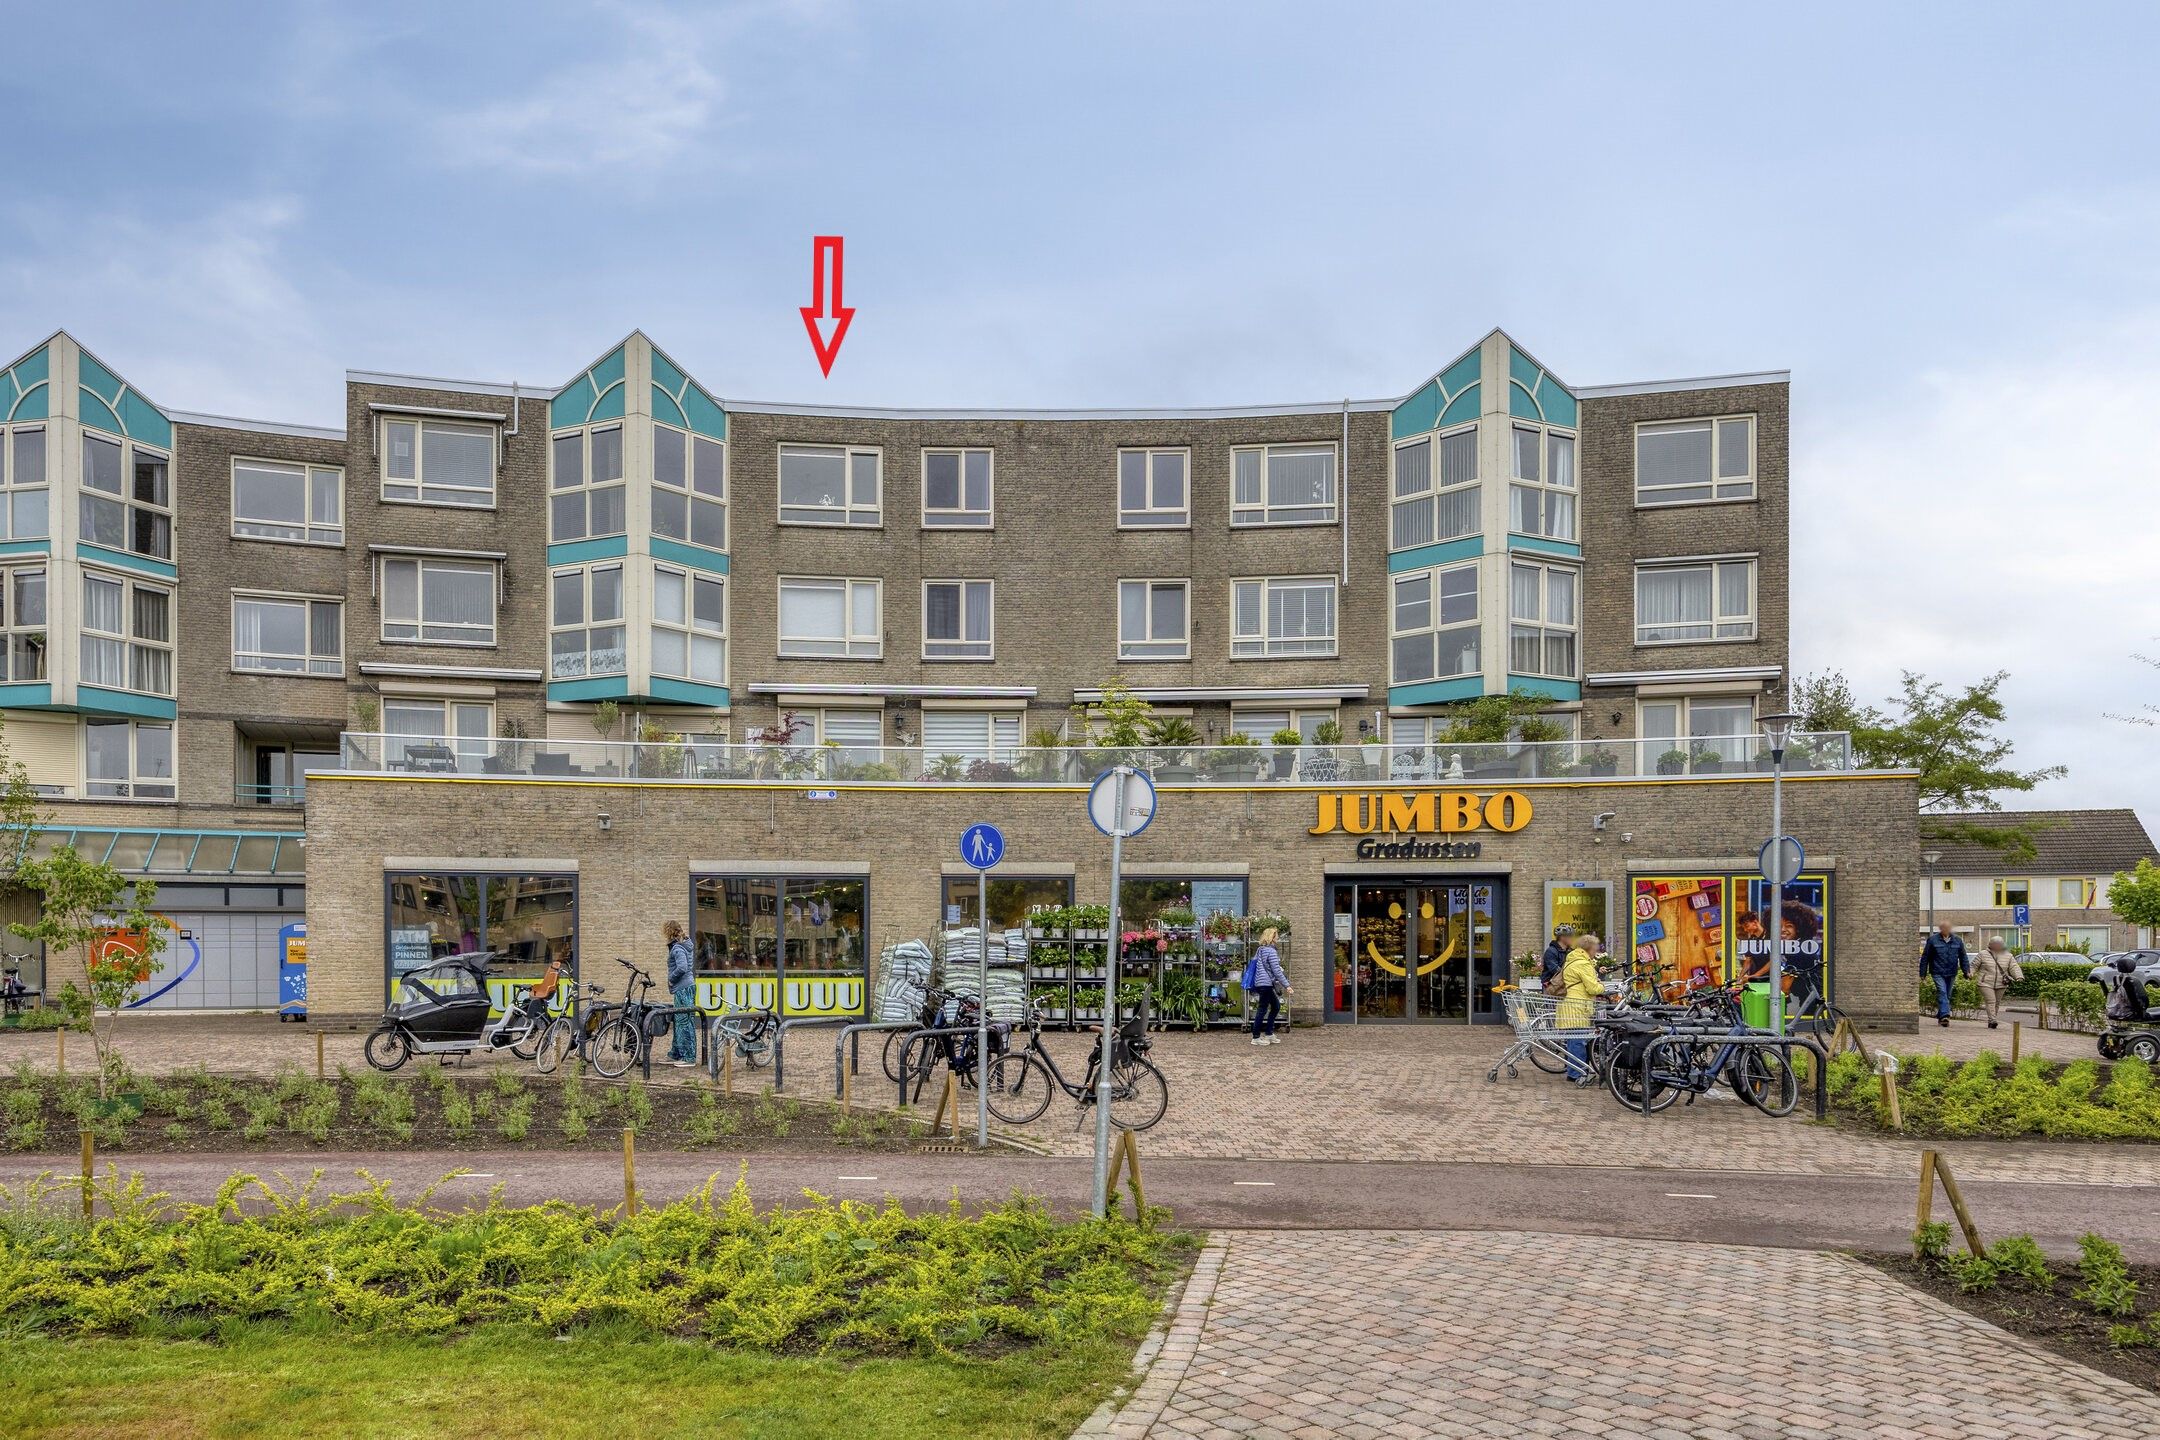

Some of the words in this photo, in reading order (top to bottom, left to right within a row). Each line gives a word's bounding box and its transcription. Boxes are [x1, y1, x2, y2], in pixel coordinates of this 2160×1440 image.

[1308, 791, 1534, 834] JUMBO
[1357, 837, 1482, 859] Gradussen
[1556, 896, 1601, 905] JUMBO
[2017, 907, 2026, 917] P
[396, 931, 427, 942] ATM
[395, 951, 428, 959] PINNEN
